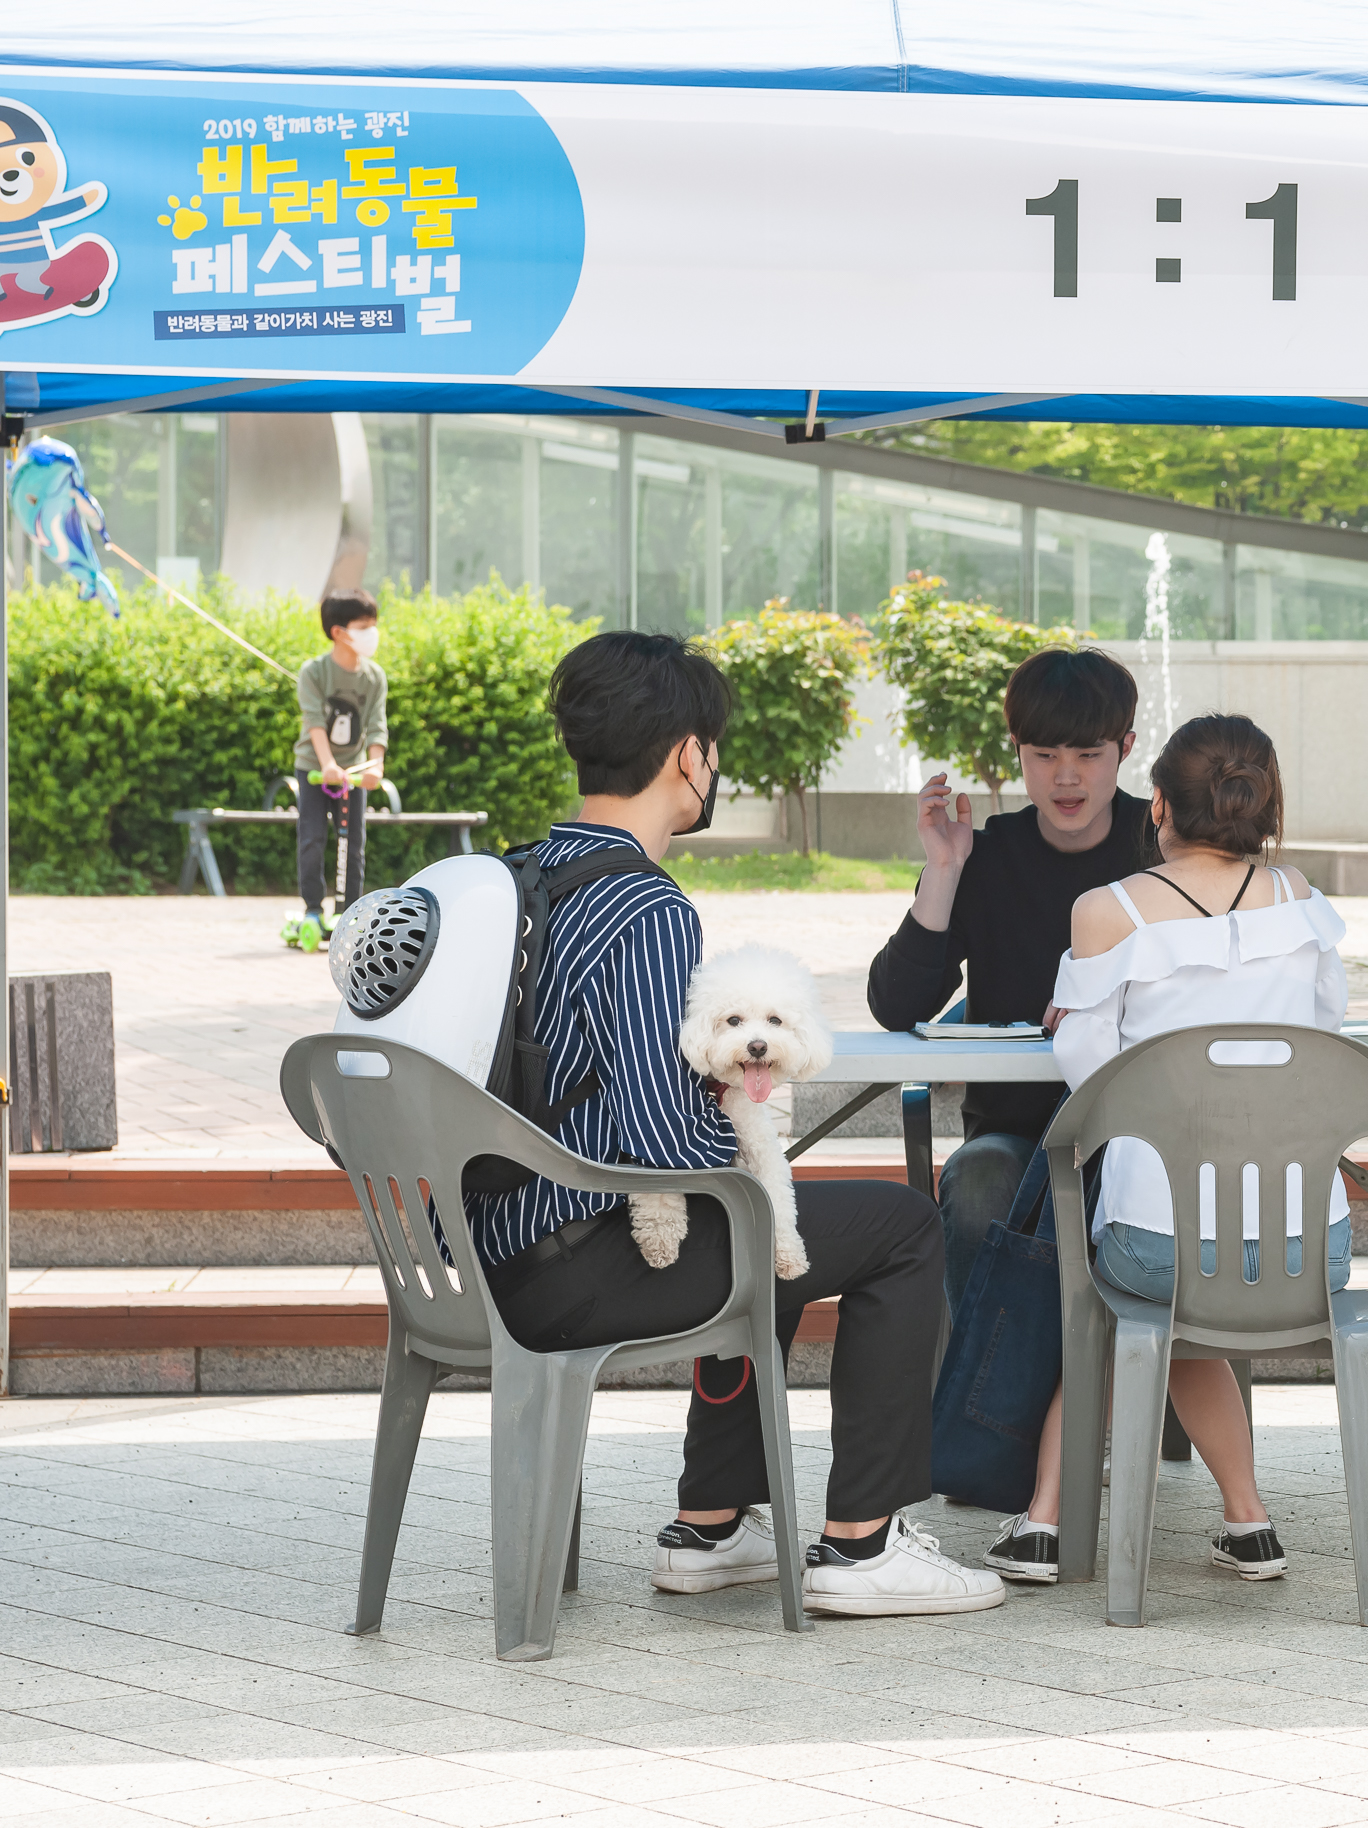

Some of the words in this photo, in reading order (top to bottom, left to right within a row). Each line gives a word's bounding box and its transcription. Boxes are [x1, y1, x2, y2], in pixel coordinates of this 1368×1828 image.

[203, 118, 257, 140] 2019
[263, 113, 357, 142] 함께하는
[364, 111, 410, 138] 광진
[197, 143, 478, 250] 반려동물
[171, 228, 472, 336] 페스티벌
[166, 313, 249, 333] 반려동물과
[253, 311, 318, 332] 같이가치
[322, 310, 356, 329] 사는
[359, 309, 393, 328] 광진
